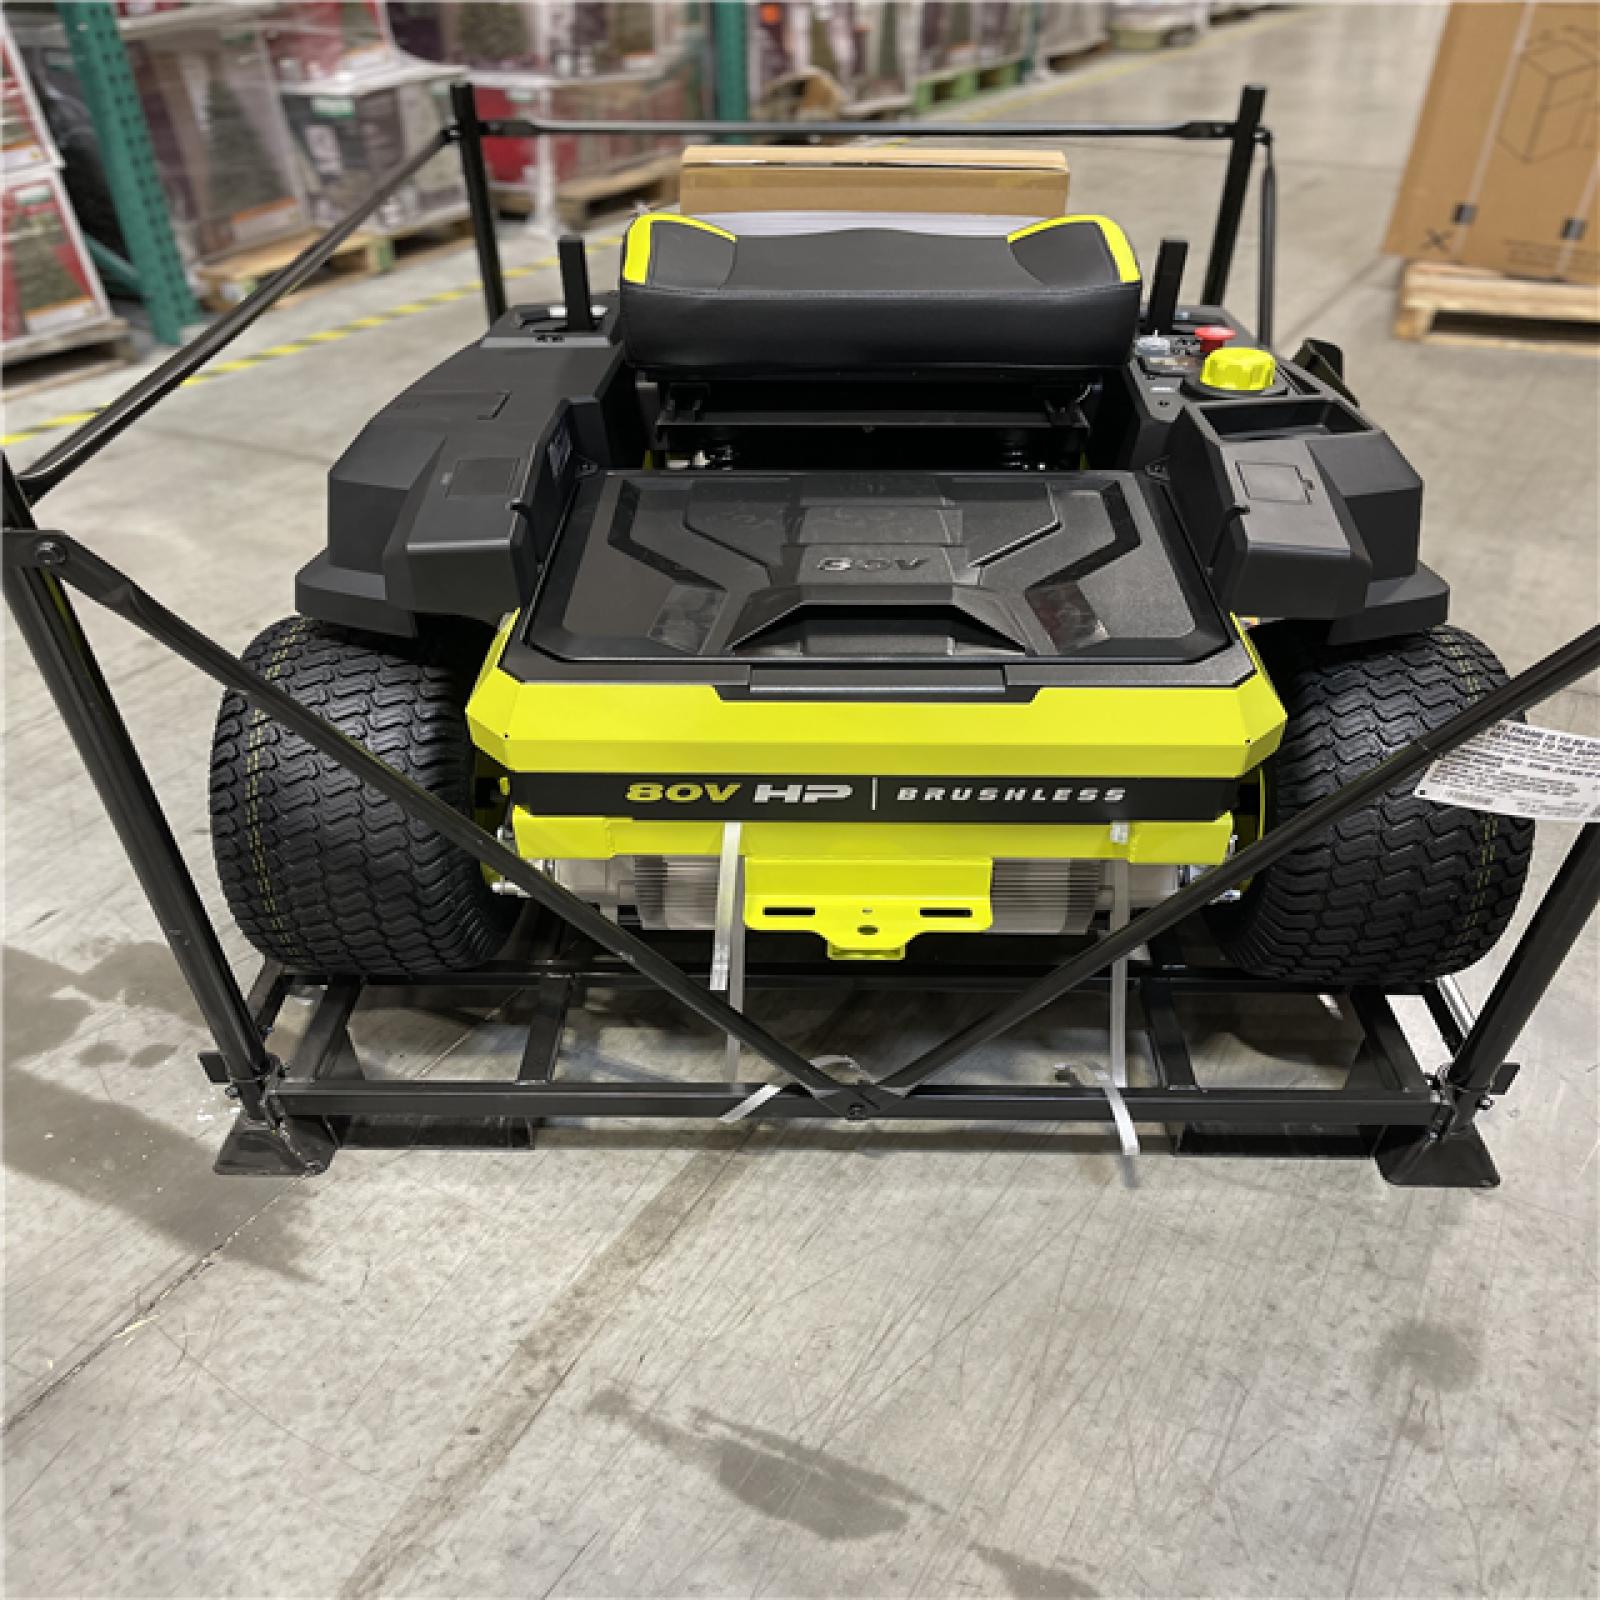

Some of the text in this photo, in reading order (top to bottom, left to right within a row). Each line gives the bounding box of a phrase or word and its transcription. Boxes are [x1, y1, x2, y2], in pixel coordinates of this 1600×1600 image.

[626, 783, 1126, 803] 80V HP BRUSHLESS
